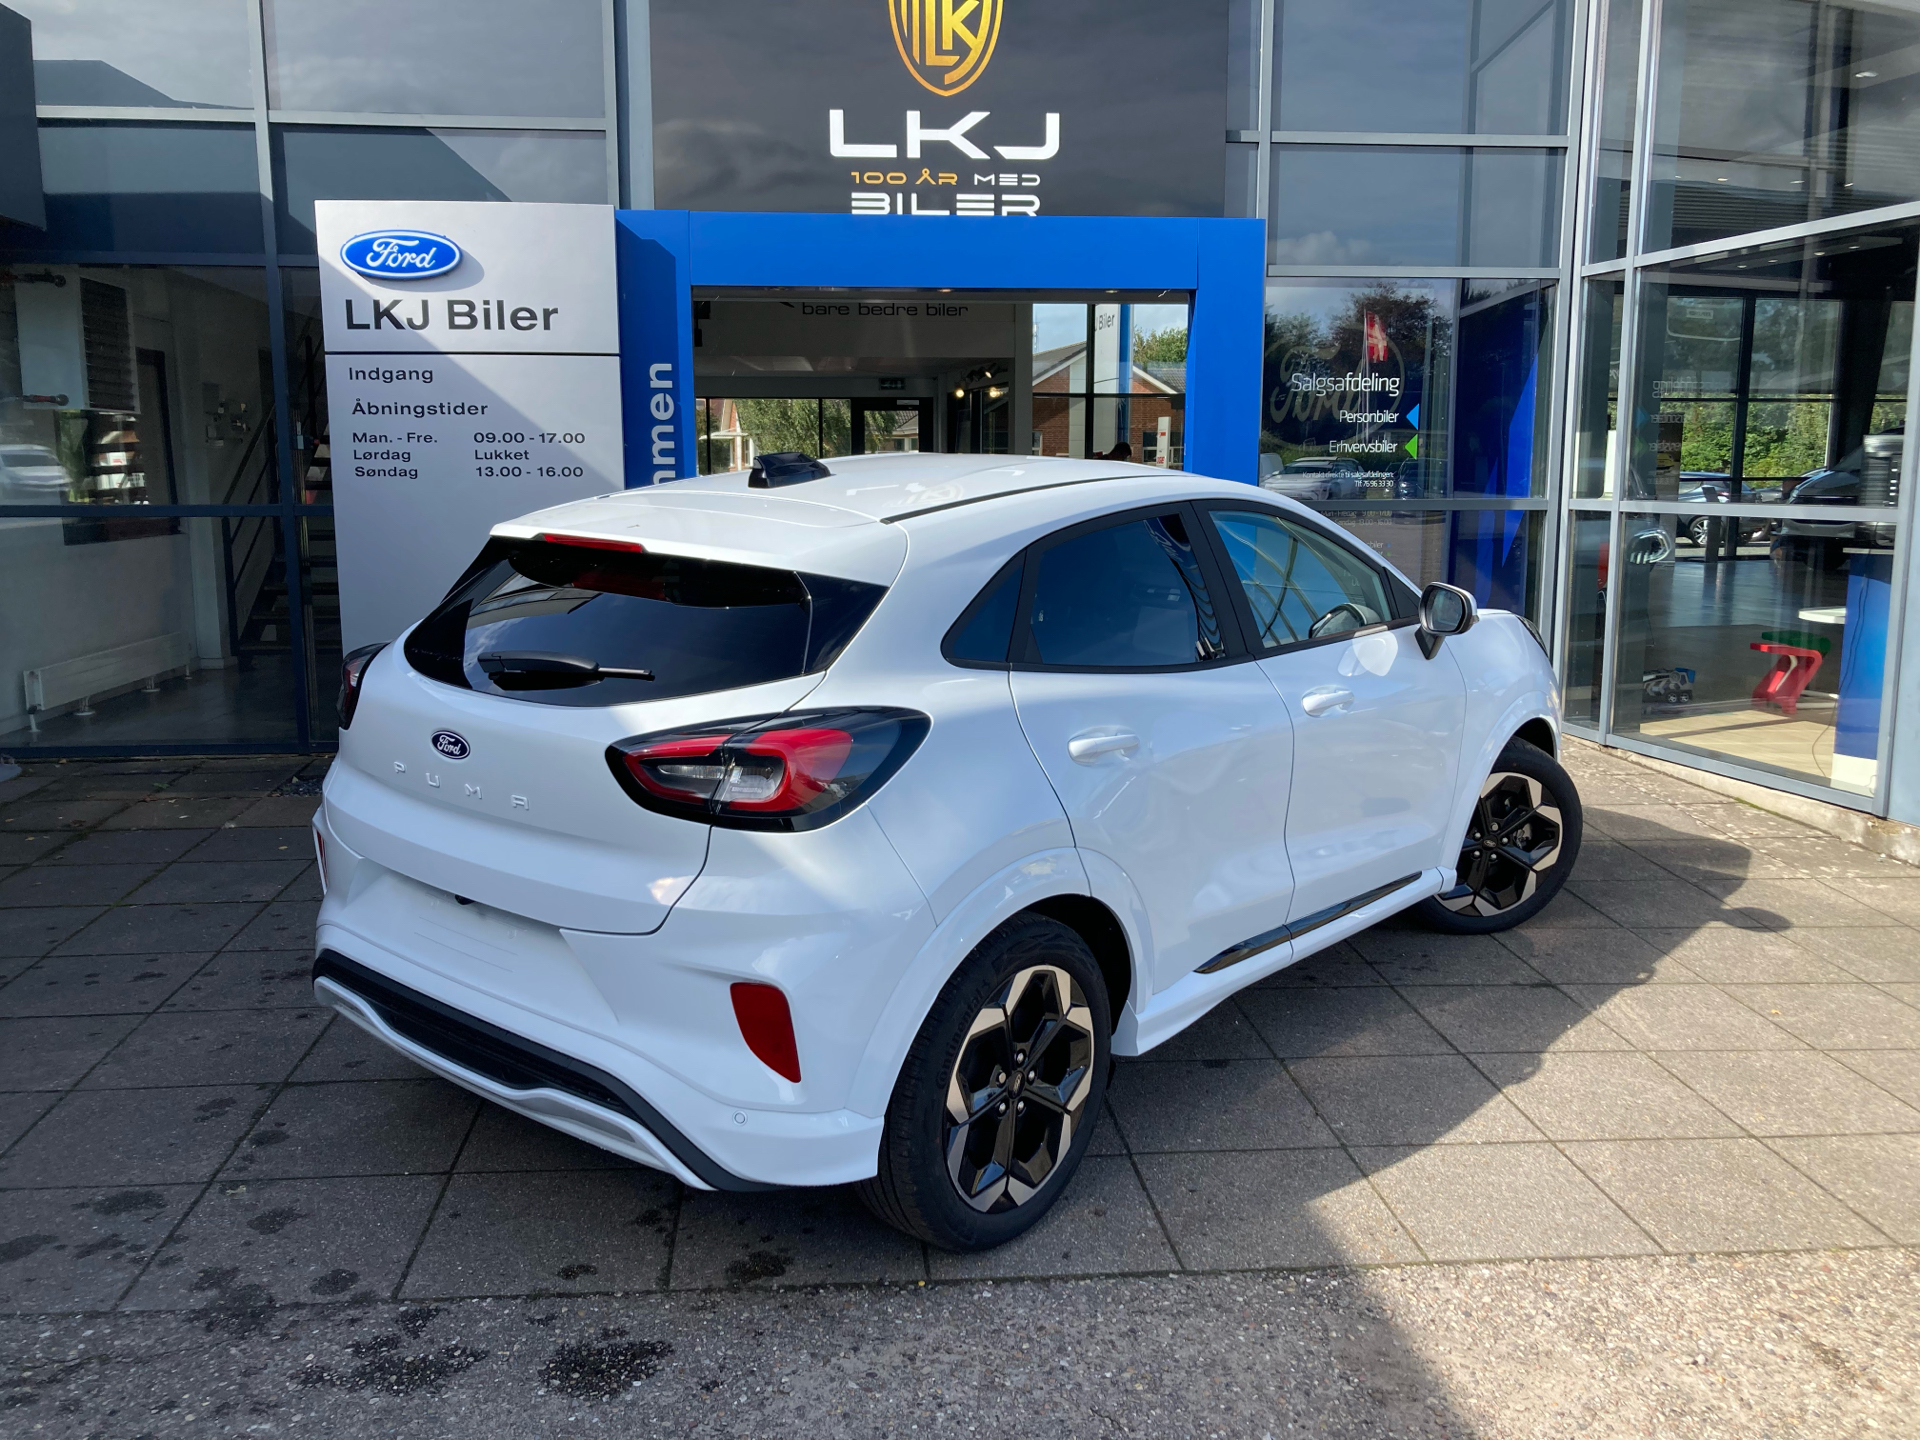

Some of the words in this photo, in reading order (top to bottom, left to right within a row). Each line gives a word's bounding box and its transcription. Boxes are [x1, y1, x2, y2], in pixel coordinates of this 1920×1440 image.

[829, 109, 1060, 160] LKJ
[851, 171, 907, 185] 100
[915, 167, 958, 185] ÅR
[974, 173, 1041, 186] MED
[851, 192, 1041, 216] BILER
[365, 237, 437, 270] Ford
[345, 298, 430, 331] LKJ
[447, 298, 559, 331] Biler
[802, 302, 850, 316] bare
[858, 302, 918, 316] bedre
[926, 303, 968, 316] biler
[349, 367, 433, 384] Indgang
[1291, 372, 1400, 397] Salgsafdeling
[352, 398, 488, 418] Åbningstider
[1339, 410, 1399, 423] Personbiler
[352, 432, 393, 443] Man.
[407, 432, 438, 443] Fre.
[473, 432, 525, 443] 09.00
[539, 432, 586, 443] 17.00
[1329, 440, 1398, 453] Erhvervsbiler
[353, 450, 411, 462] Lørdag
[475, 450, 530, 460] Lukket
[354, 466, 418, 479] Søndag
[476, 466, 522, 477] 13.00
[537, 466, 584, 477] 16.00
[436, 734, 462, 755] Ford
[393, 761, 530, 811] PUMA
[935, 987, 984, 1090] Continental
